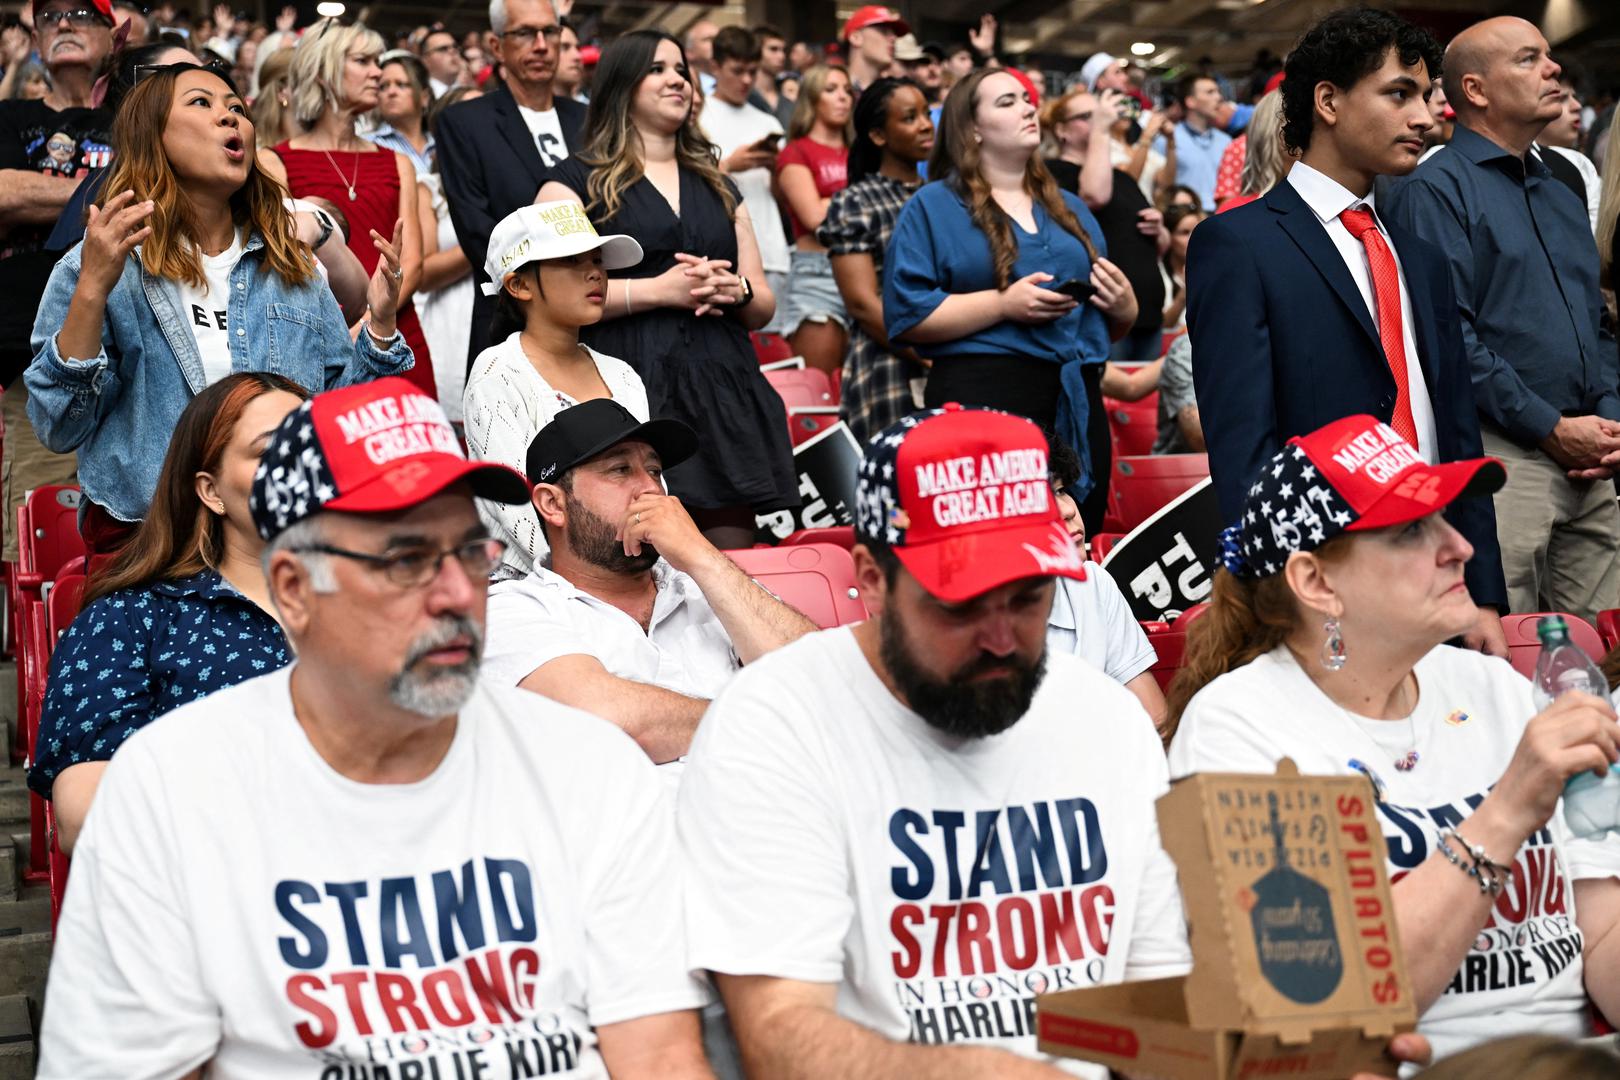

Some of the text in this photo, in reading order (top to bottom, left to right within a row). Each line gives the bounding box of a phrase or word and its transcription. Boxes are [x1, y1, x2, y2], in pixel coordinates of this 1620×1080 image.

[500, 239, 531, 268] 45/47
[336, 396, 404, 444] MAKE
[364, 422, 433, 465] GREAT
[1332, 430, 1386, 475] MAKE
[1365, 443, 1417, 484] GREAT
[915, 456, 978, 498] MAKE
[933, 486, 1000, 527] GREAT
[889, 797, 1108, 901] STAND
[275, 857, 537, 970] STAND
[1336, 794, 1399, 1004] SPINATO'S
[890, 884, 1115, 980] STRONG
[286, 947, 540, 1049] STRONG
[939, 966, 1077, 1004] HONOR
[904, 998, 1037, 1046] HARLIE
